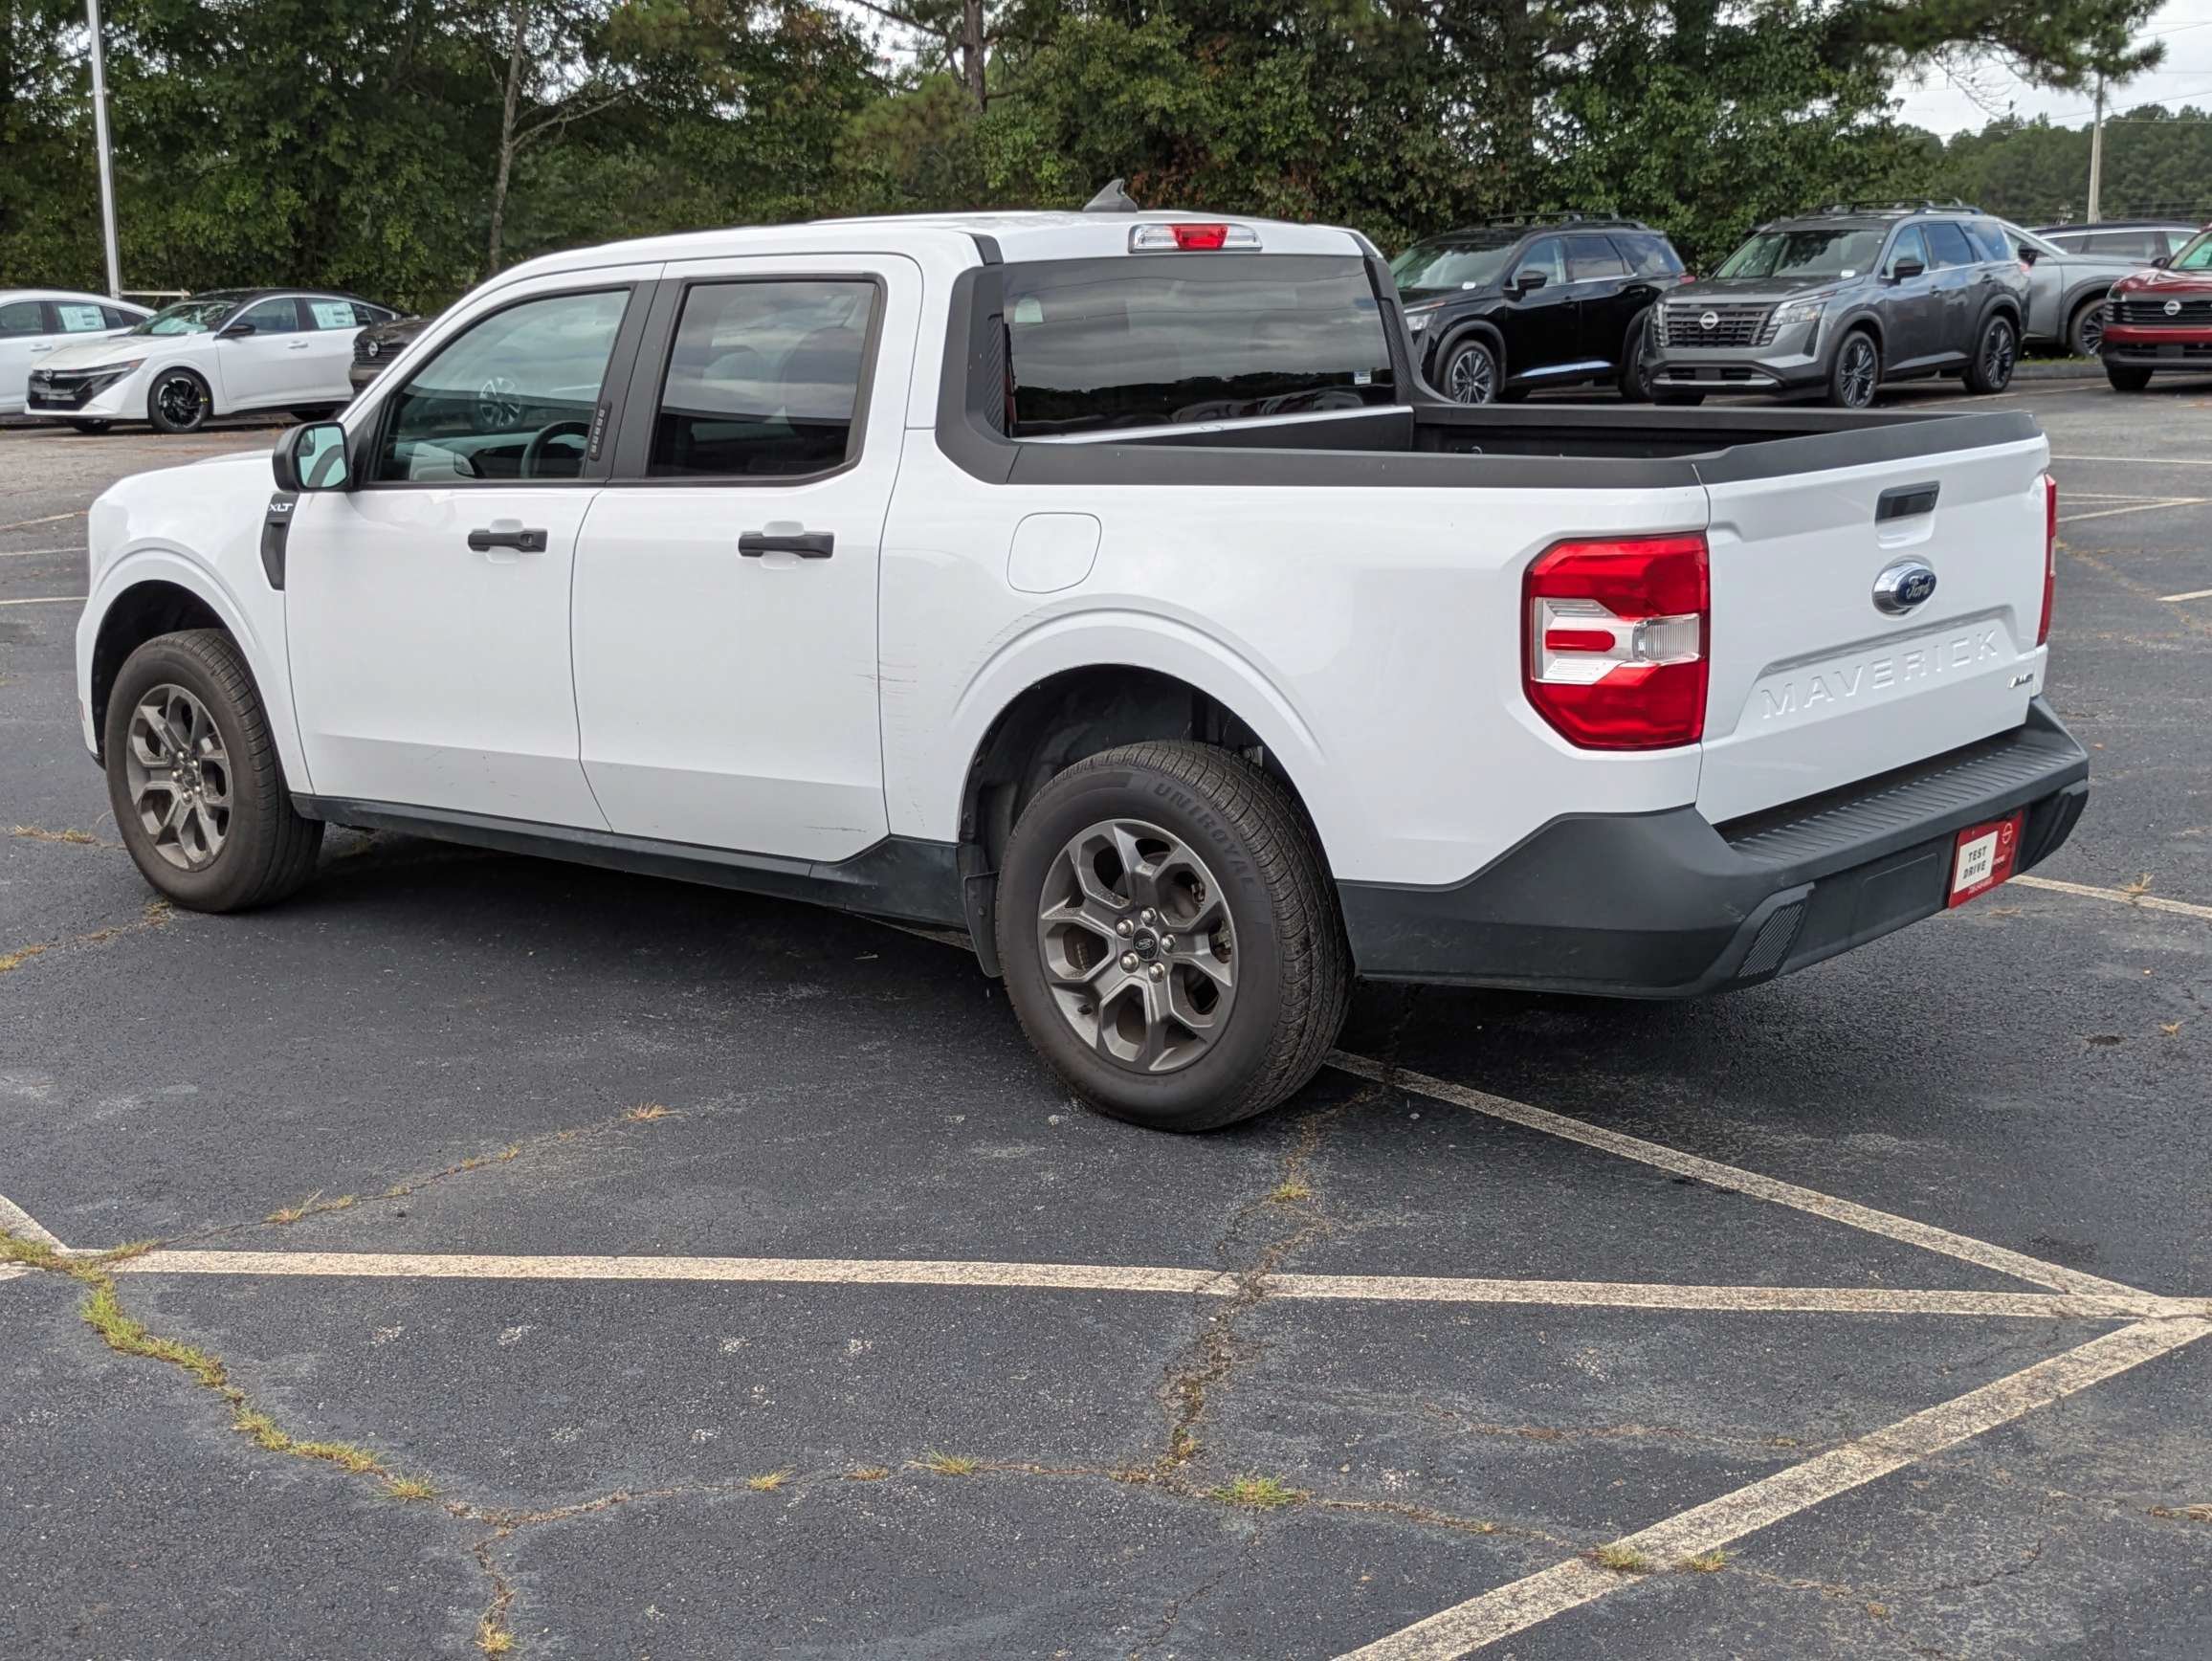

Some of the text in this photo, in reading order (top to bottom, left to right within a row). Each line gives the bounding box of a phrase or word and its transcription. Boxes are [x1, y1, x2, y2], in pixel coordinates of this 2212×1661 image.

[269, 502, 294, 512] XLT
[1761, 630, 1998, 719] MAVERICK
[1968, 846, 1987, 863] TEST
[1962, 860, 1986, 879] DRIVE
